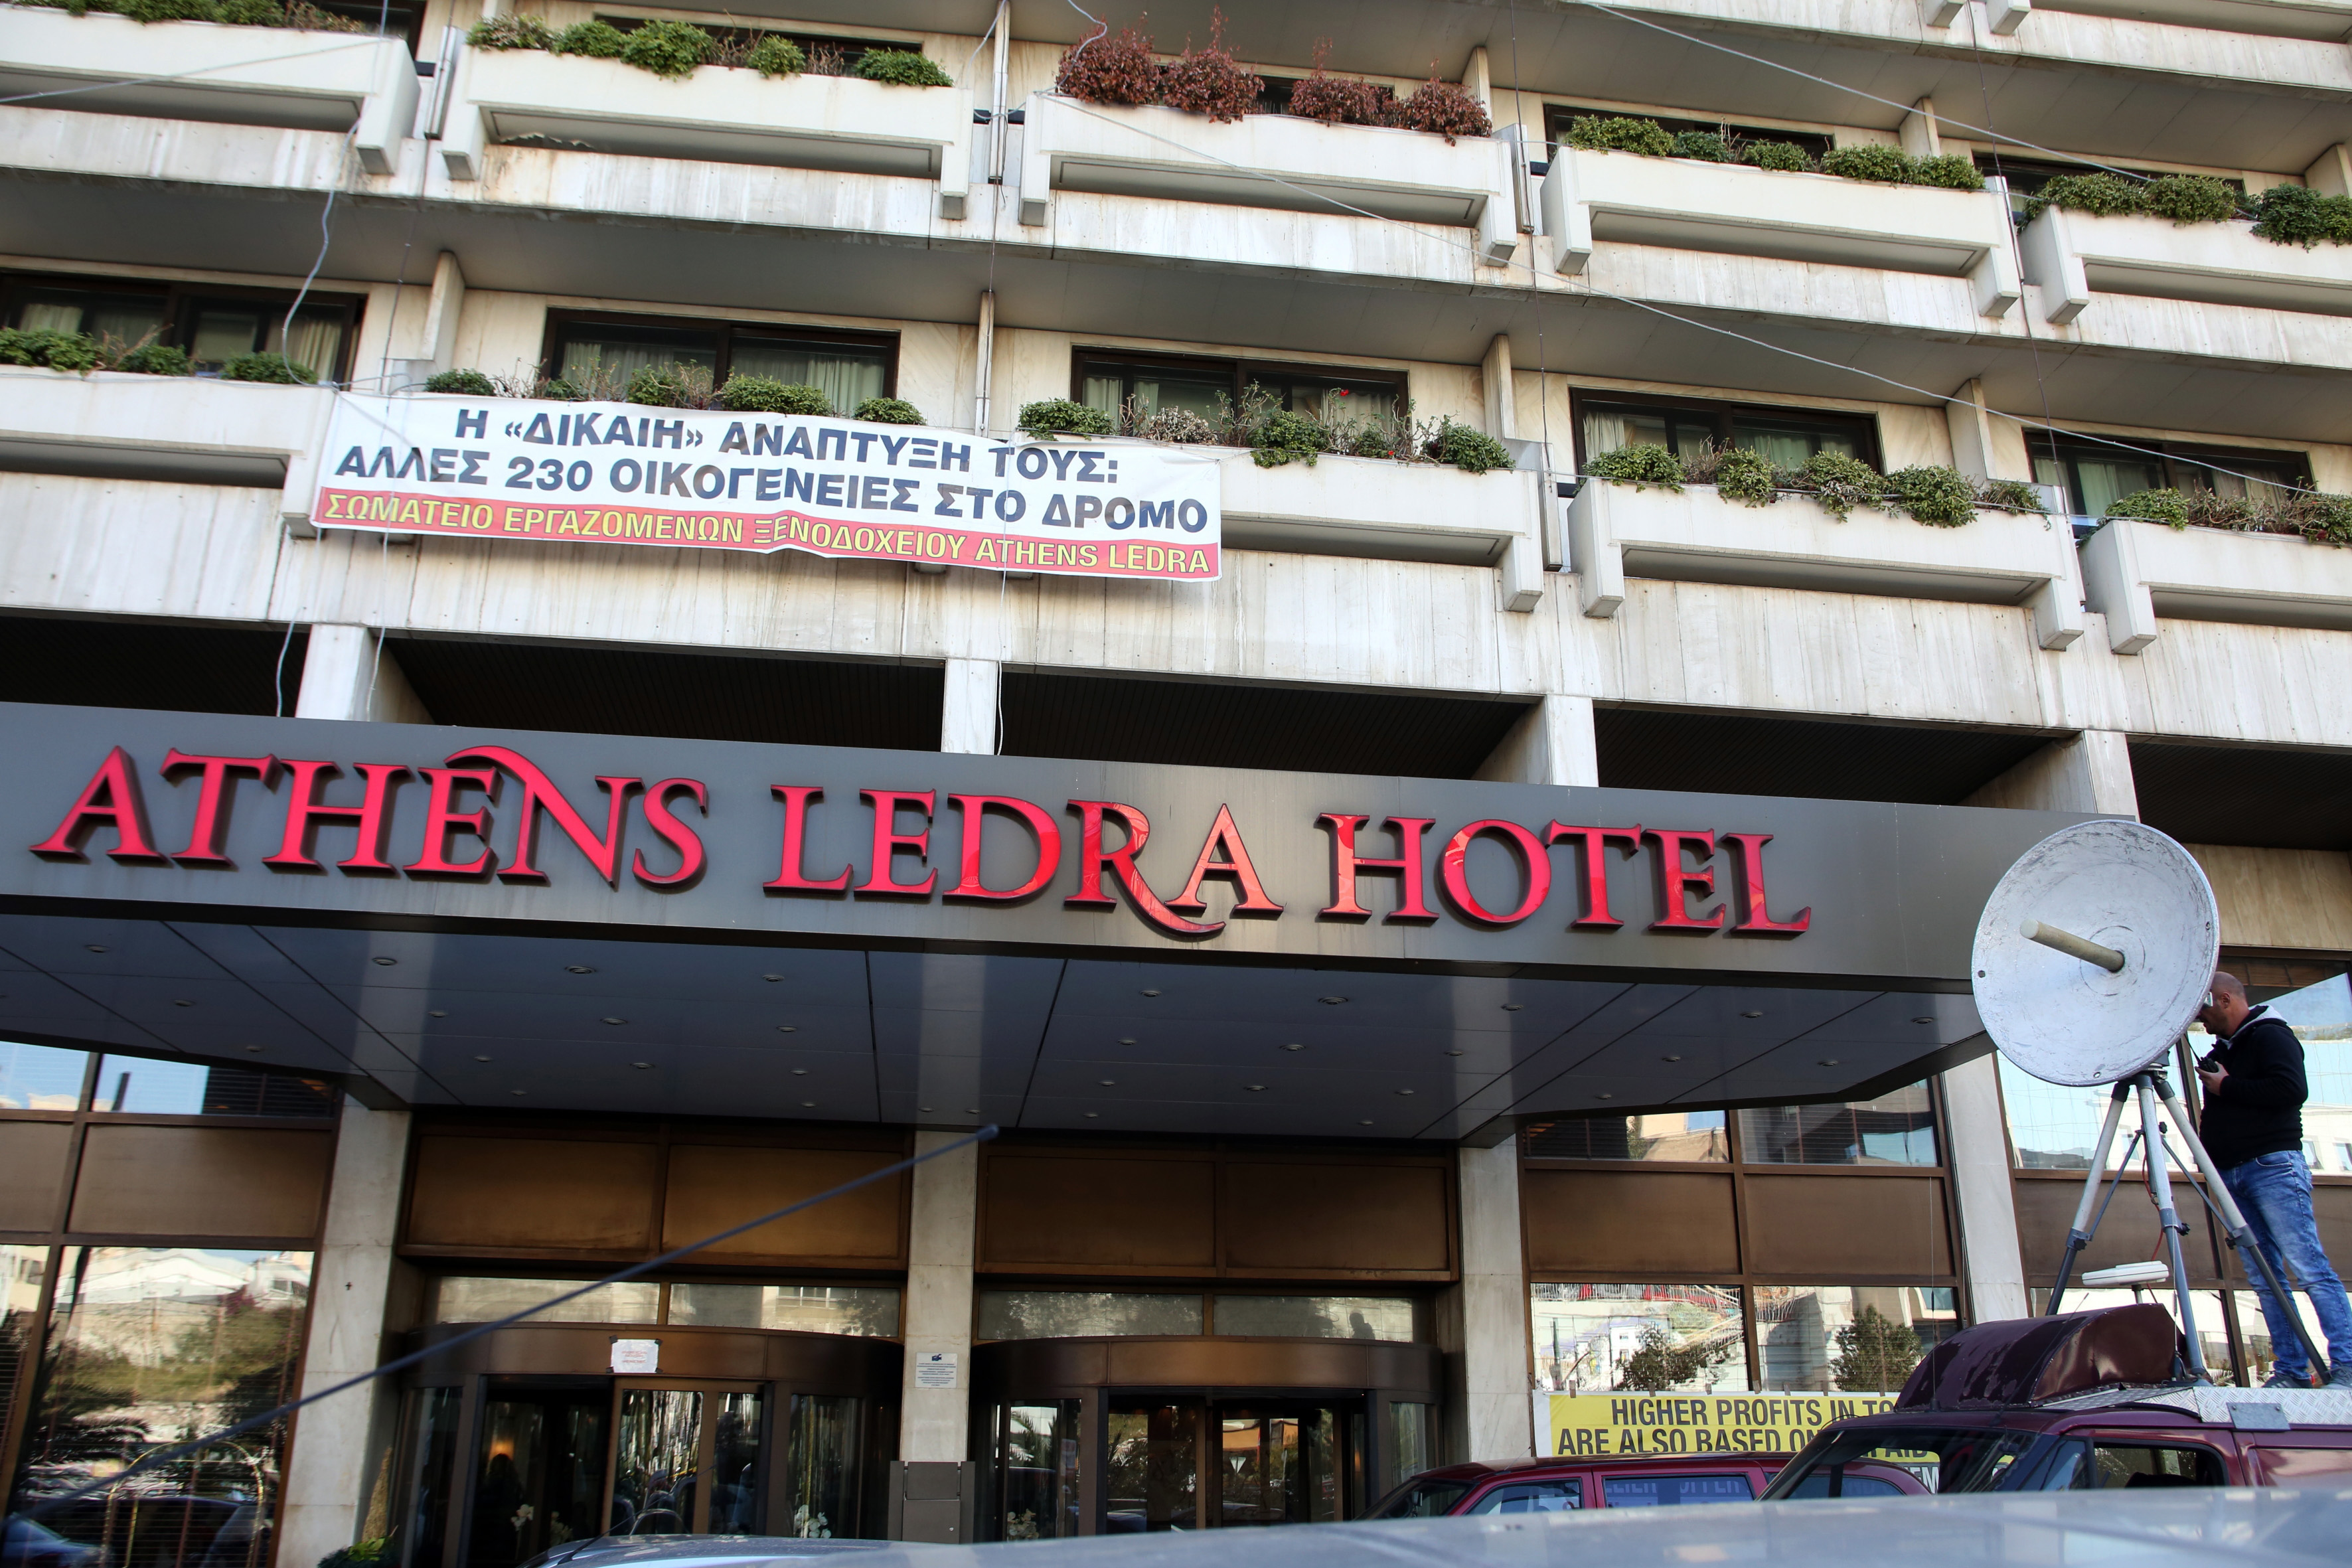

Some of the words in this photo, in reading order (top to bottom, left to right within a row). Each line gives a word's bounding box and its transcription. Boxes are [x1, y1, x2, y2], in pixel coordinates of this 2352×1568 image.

[455, 409, 488, 439] Η
[505, 412, 703, 449] «ΔΙΚΑΙΗ»
[718, 420, 971, 472] ΑΝΑΠΤΥΞΗ
[988, 446, 1119, 484] ΤΟΥΣ:
[335, 445, 490, 485] ΑΛΛΕΣ
[505, 456, 593, 492] 230
[609, 458, 920, 513] ΟΙΚΟΓΕΝΕΙΕΣ
[934, 483, 1026, 523] ΣΤΟ
[1042, 493, 1208, 532] ΔΡΟΜΟ
[324, 493, 493, 530] ΣΩΜΑΤΕΙΟ
[503, 507, 744, 544] ΕΡΓΑΖΟΜΕΝΩΝ
[753, 514, 967, 560] ΞΕΝΟΔΟΧΕΙΟΥ
[975, 536, 1098, 568] ATHENS
[1109, 542, 1210, 574] LEDRA
[29, 744, 708, 893] ATHENS
[762, 783, 1285, 939] LEDRA
[1316, 813, 1812, 940] HOTEL
[1557, 1428, 1610, 1454] ARE
[1619, 1428, 1687, 1453] ALSO
[1694, 1429, 1782, 1452] BASED
[1610, 1399, 1708, 1425] HIGHER
[1715, 1399, 1822, 1427] PROFITS
[1830, 1400, 1854, 1423] IN
